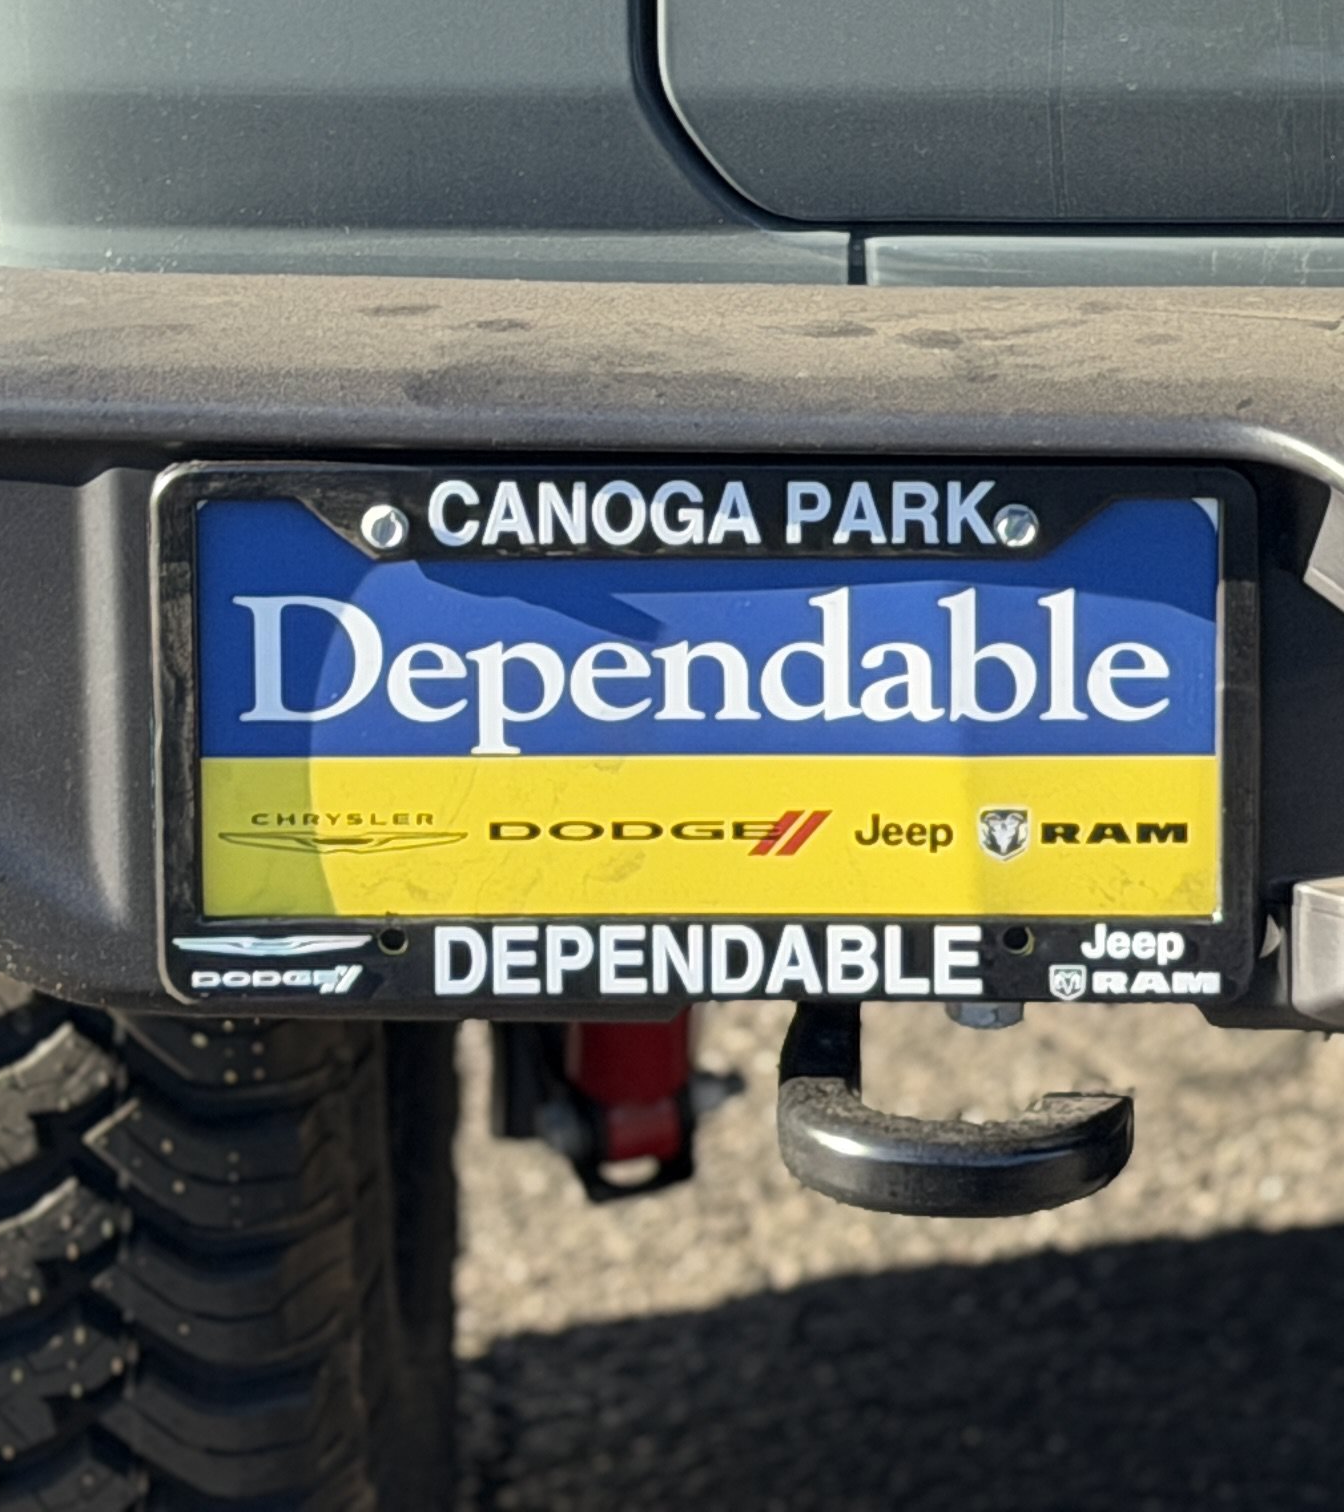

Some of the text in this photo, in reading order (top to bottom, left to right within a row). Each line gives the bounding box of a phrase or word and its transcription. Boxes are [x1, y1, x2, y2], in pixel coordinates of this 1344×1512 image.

[427, 479, 997, 547] CANOGA PARK
[231, 586, 1171, 756] Dependable
[250, 811, 436, 828] CHRYSLER
[488, 820, 783, 842] DODGE
[853, 812, 955, 854] Jeep
[1040, 821, 1190, 846] RAM
[433, 924, 984, 996] DEPENDABLE
[1080, 924, 1185, 964] Jeep
[190, 969, 342, 989] DODGE
[1092, 970, 1221, 995] RAM
